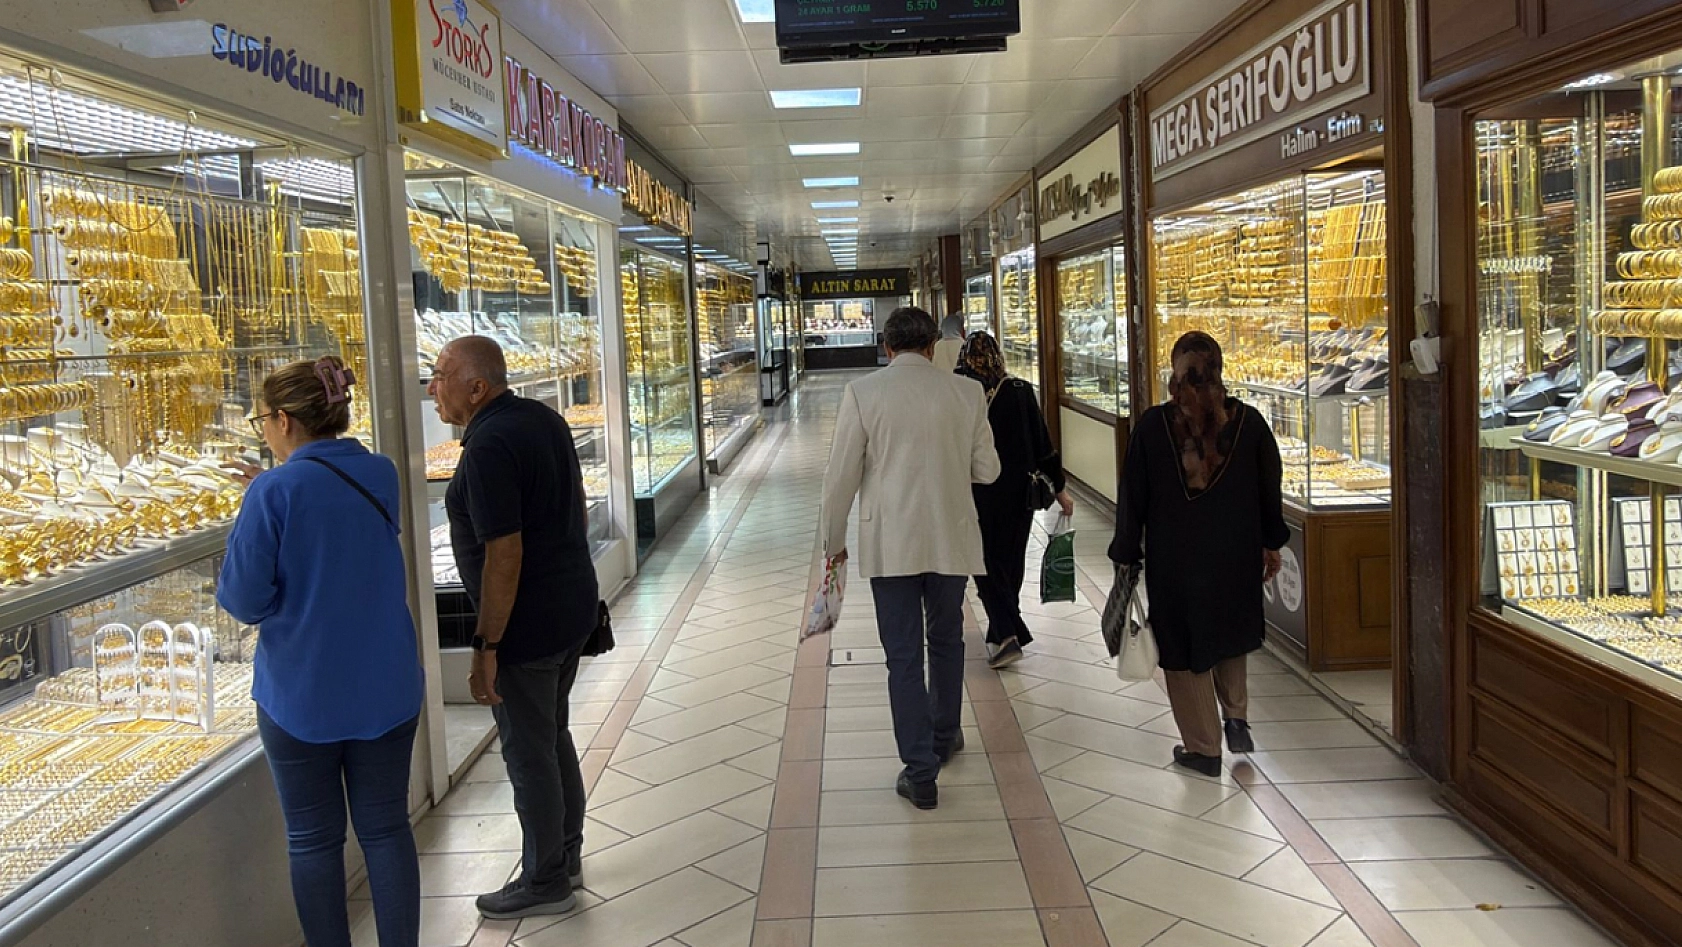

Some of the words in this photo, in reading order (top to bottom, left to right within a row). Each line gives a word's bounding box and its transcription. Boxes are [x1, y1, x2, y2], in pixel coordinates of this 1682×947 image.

[809, 6, 834, 15] AYAR
[843, 4, 871, 14] GRAM
[906, 0, 937, 11] 5.570
[428, 0, 493, 80] STORKS
[1152, 98, 1203, 168] MEGA
[1206, 3, 1357, 148] ŞERİFOĞLU
[1281, 126, 1317, 159] Halim
[1327, 110, 1362, 142] Erim
[811, 279, 850, 294] ALTIN
[853, 278, 896, 292] SARAY
